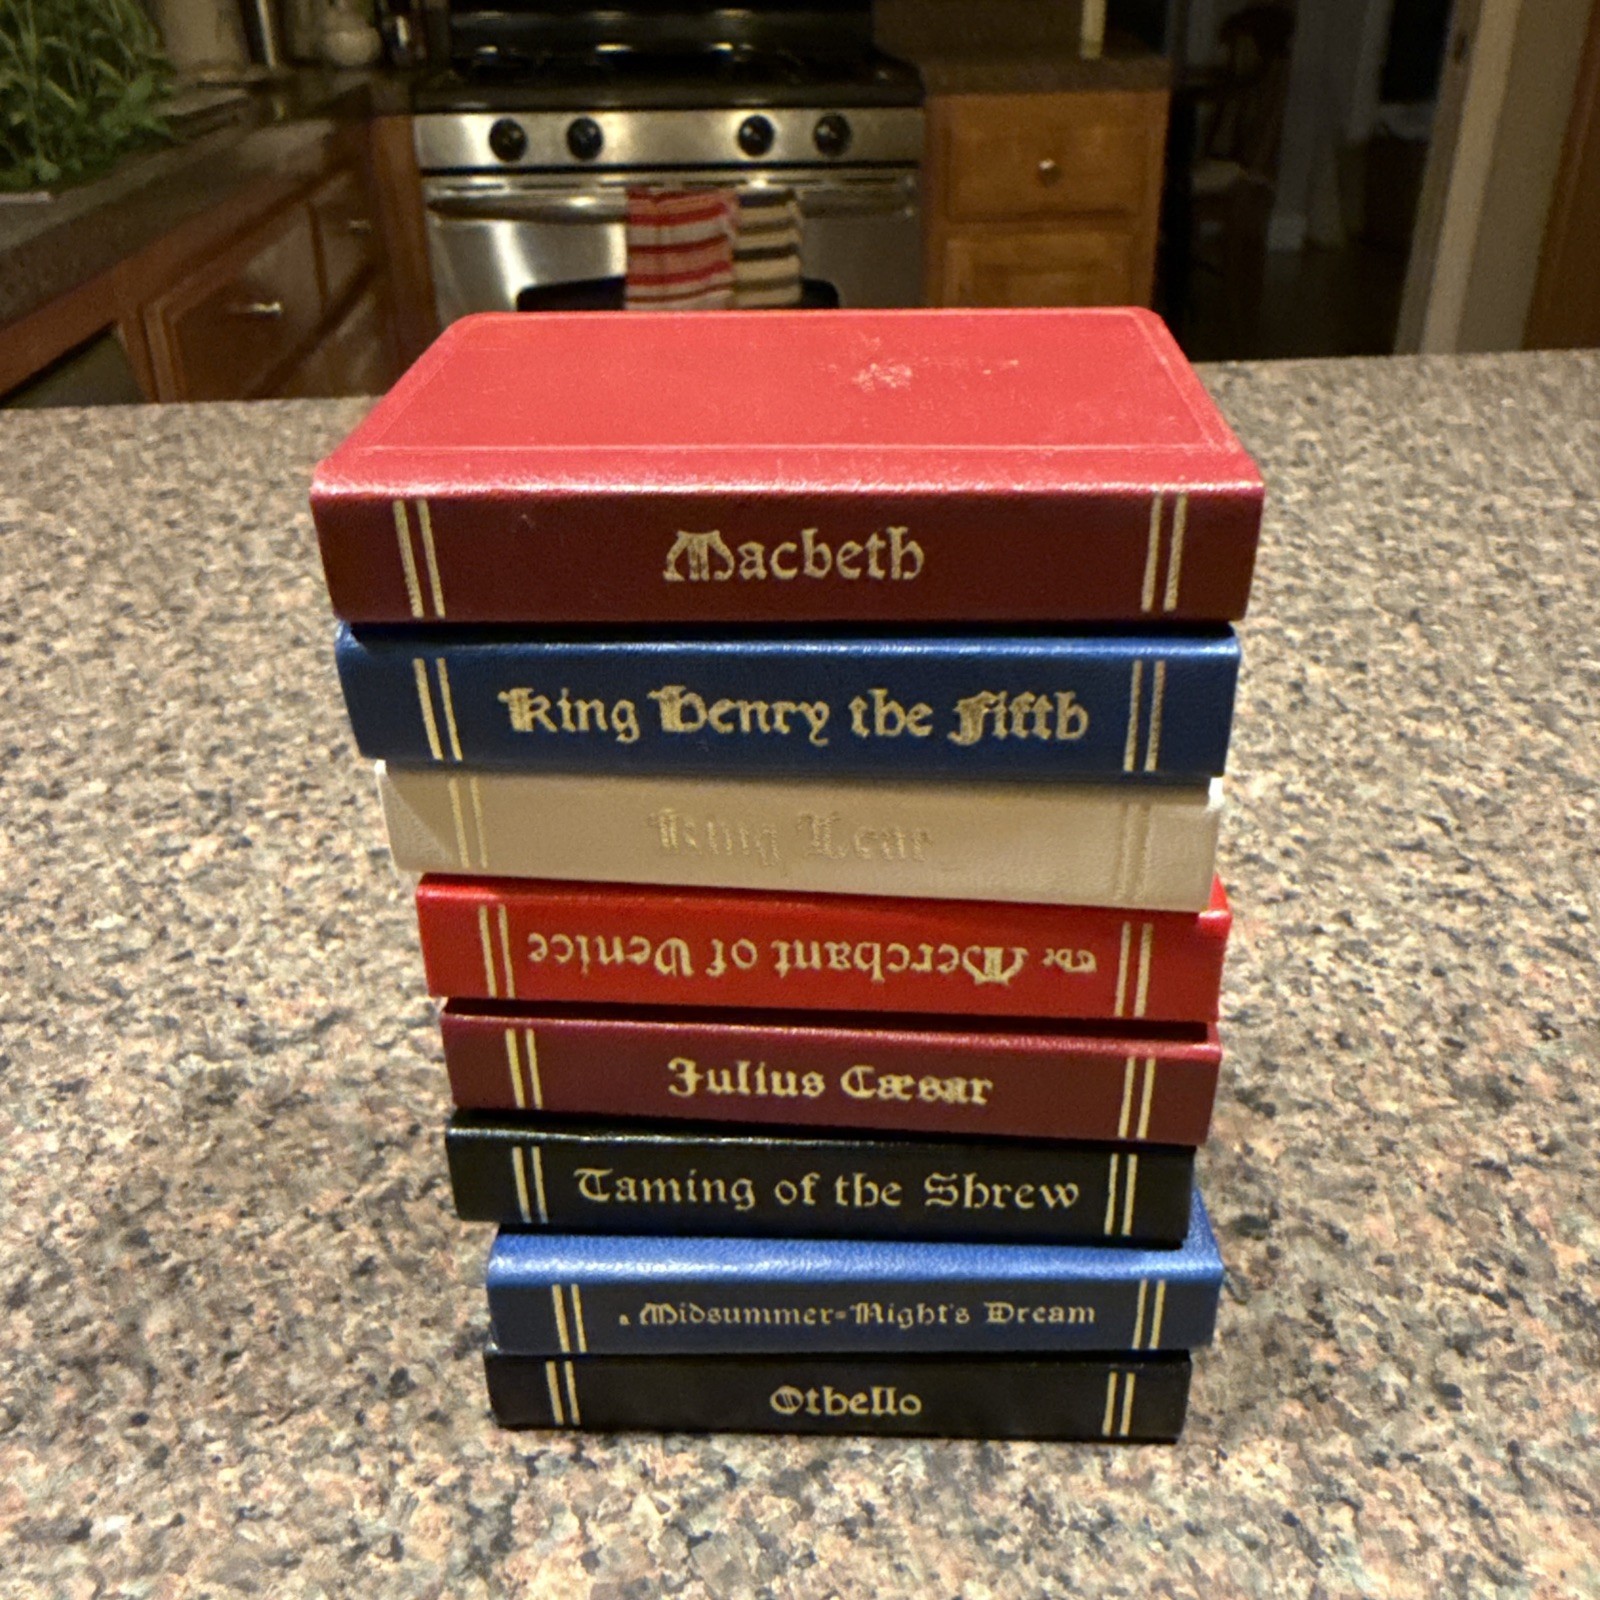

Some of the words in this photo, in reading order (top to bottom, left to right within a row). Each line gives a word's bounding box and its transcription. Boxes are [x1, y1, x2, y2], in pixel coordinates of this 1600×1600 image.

[662, 525, 926, 584] Macbeth
[497, 686, 641, 745] King
[647, 685, 831, 748] Henry
[848, 689, 934, 740] the
[947, 689, 1090, 747] Fifth
[648, 806, 786, 870] King
[528, 932, 696, 978] Venice
[705, 938, 759, 978] of
[771, 940, 1030, 987] Merchant
[667, 1057, 827, 1099] Julius
[573, 1168, 757, 1213] Taming
[774, 1174, 821, 1207] of
[835, 1174, 903, 1208] the
[924, 1172, 1080, 1211] Shrew
[984, 1301, 1096, 1325] Dream
[769, 1385, 923, 1417] Othello
